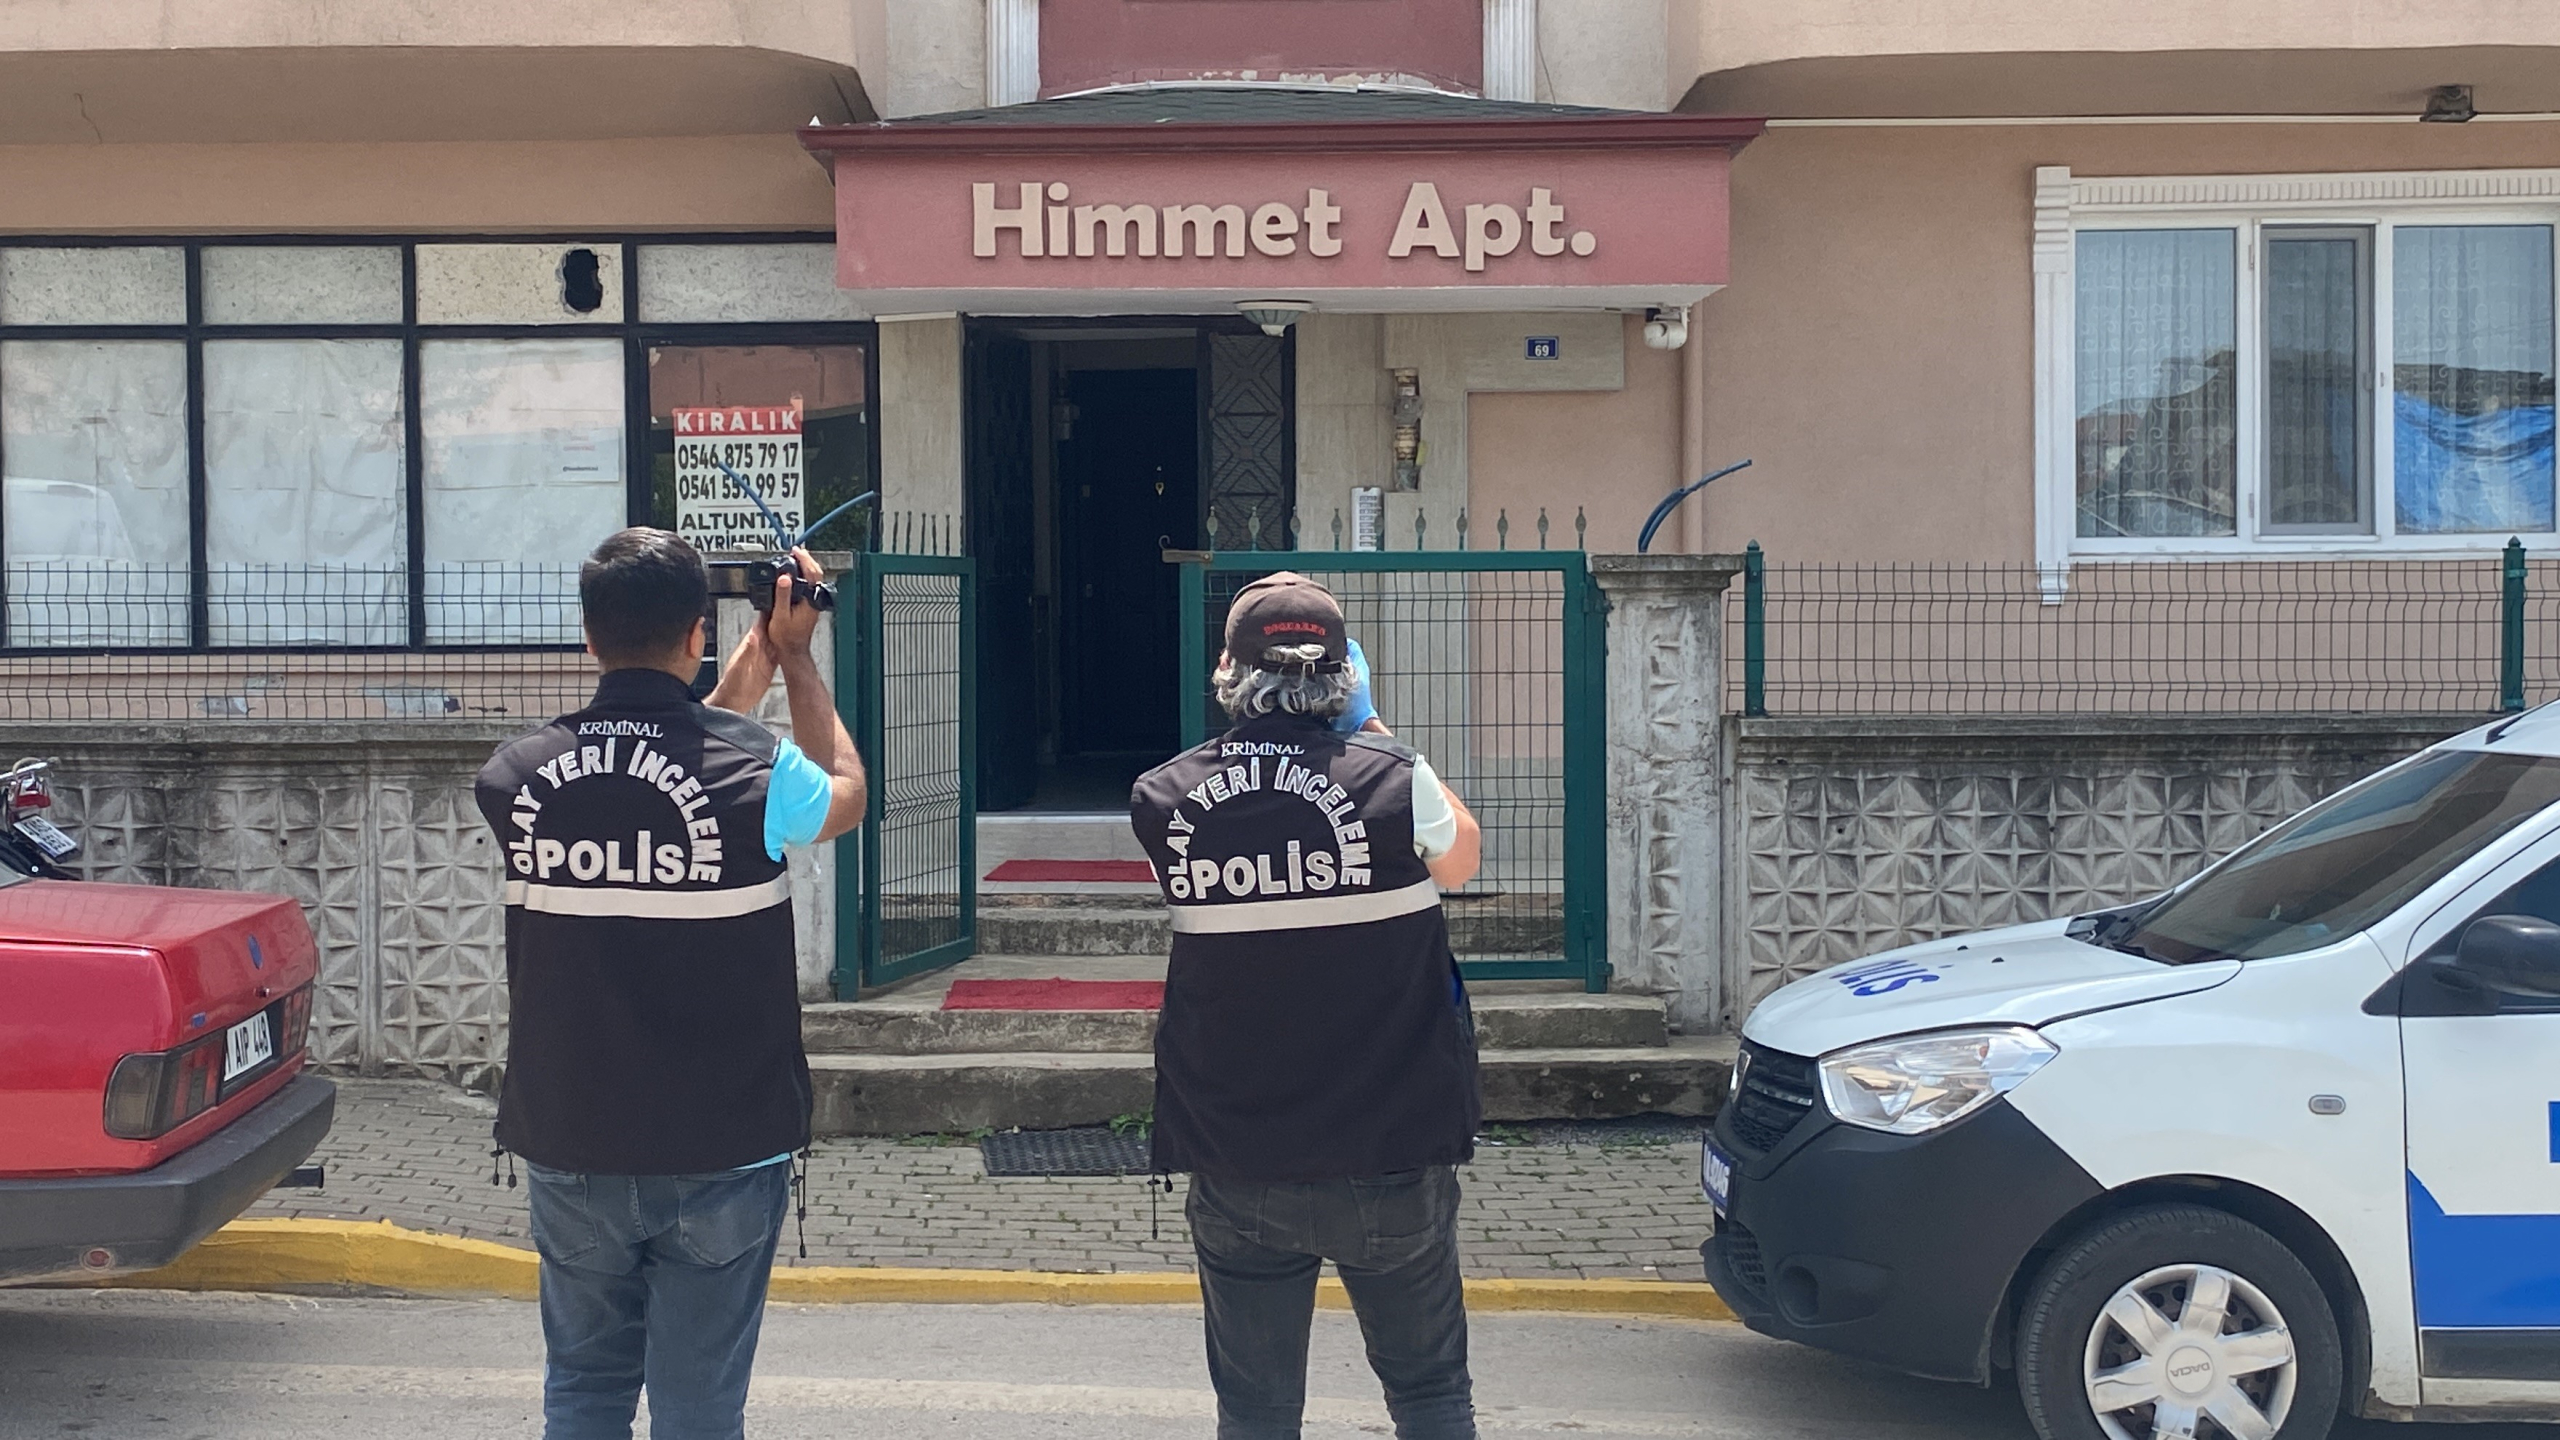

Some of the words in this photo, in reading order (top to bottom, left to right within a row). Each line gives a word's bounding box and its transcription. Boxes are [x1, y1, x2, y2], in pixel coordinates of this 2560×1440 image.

[972, 181, 1342, 257] Himmet
[1388, 181, 1597, 271] Apt.
[1534, 344, 1550, 357] 69
[678, 443, 719, 470] 0546
[724, 443, 753, 469] 875
[758, 442, 778, 468] 79
[782, 442, 799, 468] 17
[679, 474, 716, 500] 0541
[756, 473, 776, 499] 99
[781, 472, 800, 498] 57
[681, 511, 800, 532] ALTUNTAŞ
[508, 784, 543, 875] OLAY
[536, 736, 616, 790] YERİ
[627, 739, 723, 884] İNCELEME
[1166, 808, 1195, 900] OLAY
[1186, 756, 1261, 812] YERİ
[1273, 756, 1372, 886] İNCELEME
[535, 830, 686, 885] POLİS
[1190, 839, 1337, 900] POLİS
[2169, 1361, 2211, 1377] DACIA
